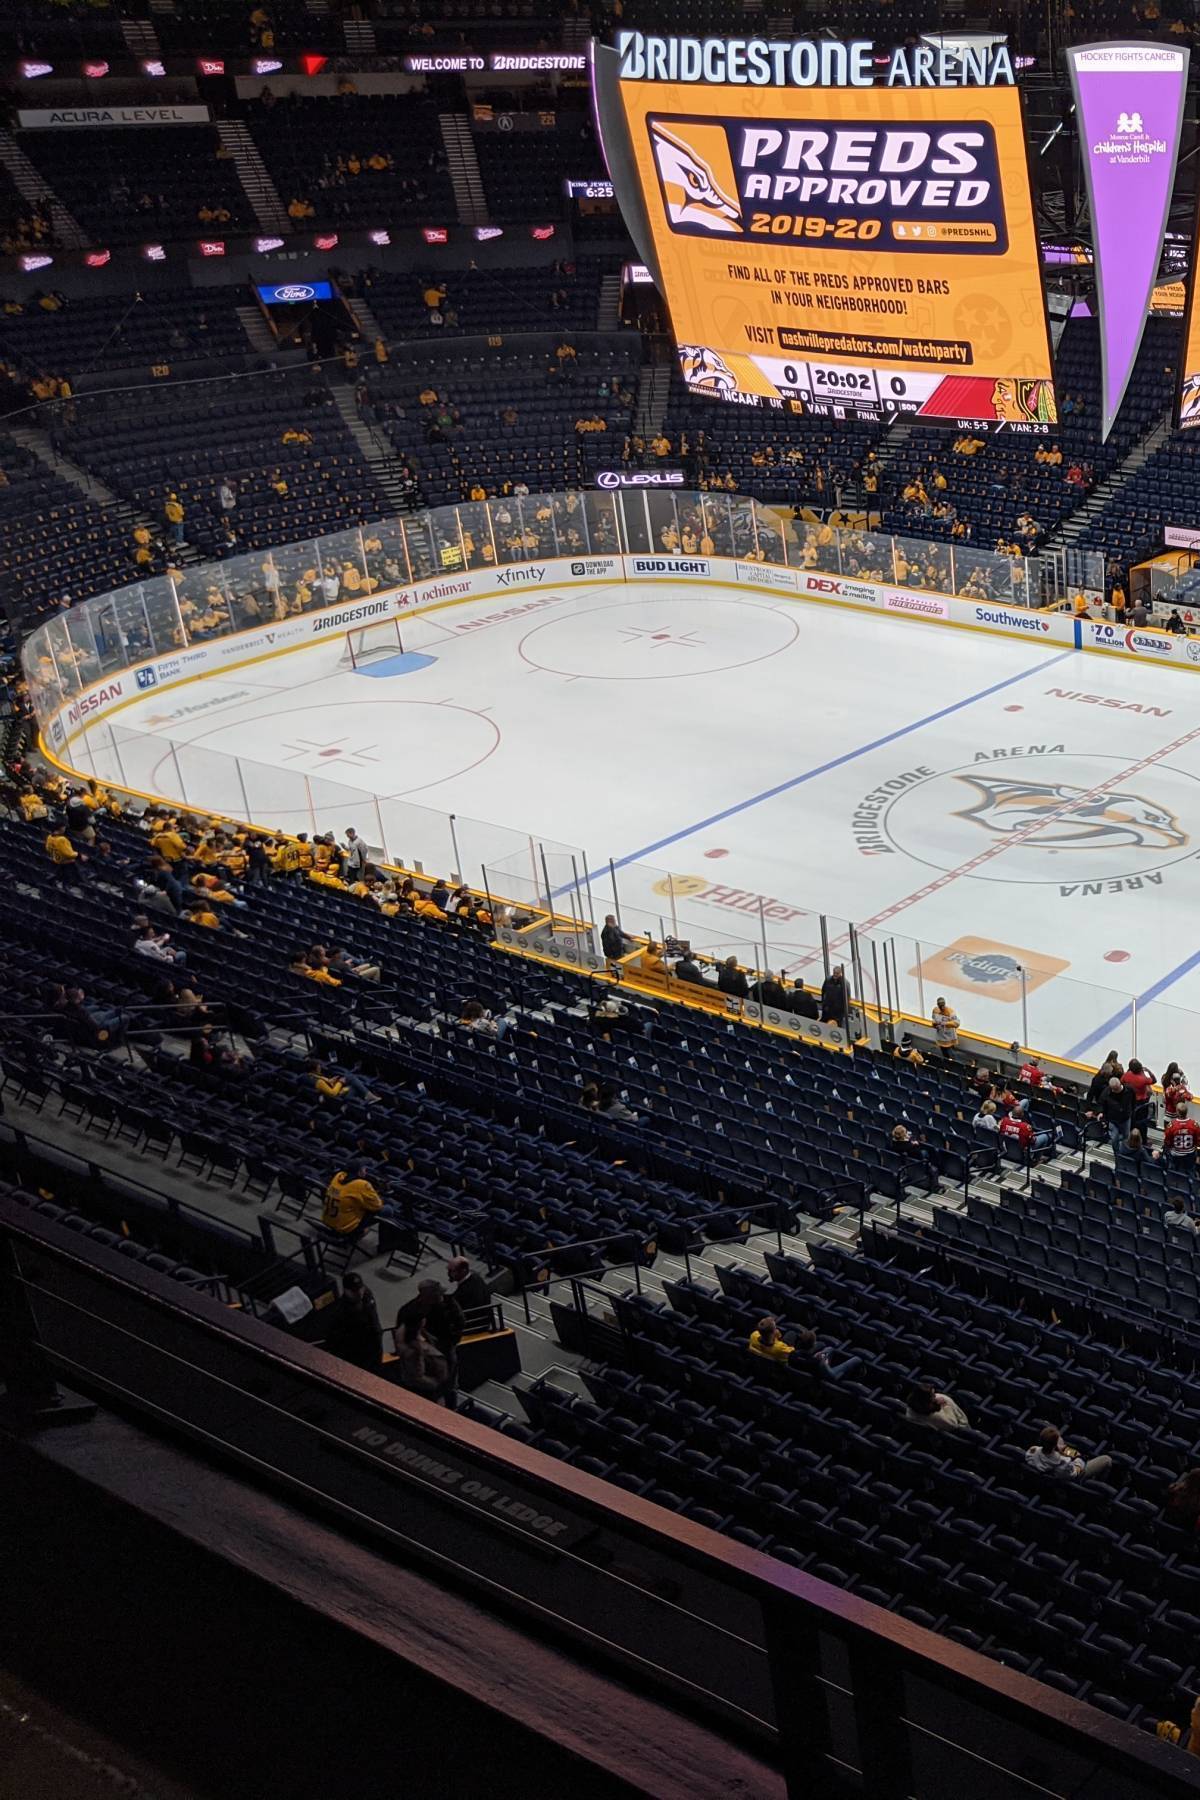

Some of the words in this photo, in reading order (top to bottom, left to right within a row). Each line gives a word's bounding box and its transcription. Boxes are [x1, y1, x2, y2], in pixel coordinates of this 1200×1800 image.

[411, 58, 467, 70] WELCOME
[469, 58, 484, 70] TO
[493, 56, 586, 70] BRIDGESTONE
[618, 31, 875, 86] BRIDGESTONE
[888, 47, 1015, 87] ARENA
[1080, 52, 1112, 60] HOCKEY
[1115, 52, 1143, 60] FIGHTS
[1145, 52, 1176, 60] CANCER
[50, 111, 113, 123] ACURA
[122, 109, 183, 120] LEVEL
[740, 127, 985, 174] PREDS
[586, 188, 613, 198] 6:25
[744, 173, 990, 208] APPROVED
[751, 213, 881, 240] 2019-20
[941, 227, 992, 237] @PREDSNHL
[728, 264, 750, 281] FIND
[754, 267, 772, 283] ALL
[774, 270, 787, 284] OF
[790, 271, 811, 287] THE
[814, 273, 848, 289] PREDS
[853, 275, 913, 293] APPROVED
[918, 279, 950, 295] BARS
[282, 288, 307, 298] Ford
[771, 290, 782, 305] IN
[785, 291, 813, 309] YOUR
[816, 295, 908, 315] NEIGHBORHOOD!
[744, 324, 774, 344] VISIT
[782, 331, 967, 362] nashvillepredators.com/watchparty
[784, 365, 798, 384] 0
[815, 369, 871, 391] 20:02
[890, 375, 907, 396] 0
[801, 390, 809, 401] 0
[886, 401, 895, 411] 0
[723, 389, 760, 407] NCAAF
[769, 398, 783, 409] UK
[807, 404, 829, 416] VAN
[857, 411, 880, 422] FINAL
[957, 420, 973, 430] UK:
[974, 421, 989, 430] 5-5
[1010, 423, 1032, 433] VAN:
[1033, 425, 1049, 433] 2-8
[621, 473, 684, 484] LEXUS
[496, 565, 546, 586] xfinity
[586, 567, 596, 576] THE
[597, 567, 607, 575] APP
[636, 560, 666, 572] BUD
[668, 561, 706, 573] LIGHT
[413, 579, 472, 604] Lochinvar
[806, 577, 842, 595] DEX
[844, 583, 875, 595] imaging
[849, 591, 876, 601] mailing
[312, 600, 389, 633] BRIDGESTONE
[456, 595, 564, 631] NISSAN
[888, 598, 943, 615] PREDATORS
[975, 607, 1041, 631] Southwest
[1091, 624, 1114, 637] $70
[1095, 636, 1124, 648] MILLION
[158, 660, 180, 673] FIFTH
[181, 651, 207, 664] THIRD
[159, 667, 183, 680] BANK
[68, 681, 123, 725] NISSAN
[1044, 687, 1173, 718] NISSAN
[973, 744, 1066, 763] ARENA
[850, 765, 937, 857] BRIDGESTONE
[1059, 870, 1165, 898] ARENA
[695, 884, 808, 922] Hiller
[352, 1426, 386, 1447] NO
[385, 1441, 462, 1486] DRINKS
[459, 1480, 498, 1502] ON
[493, 1496, 569, 1537] LEDGE
